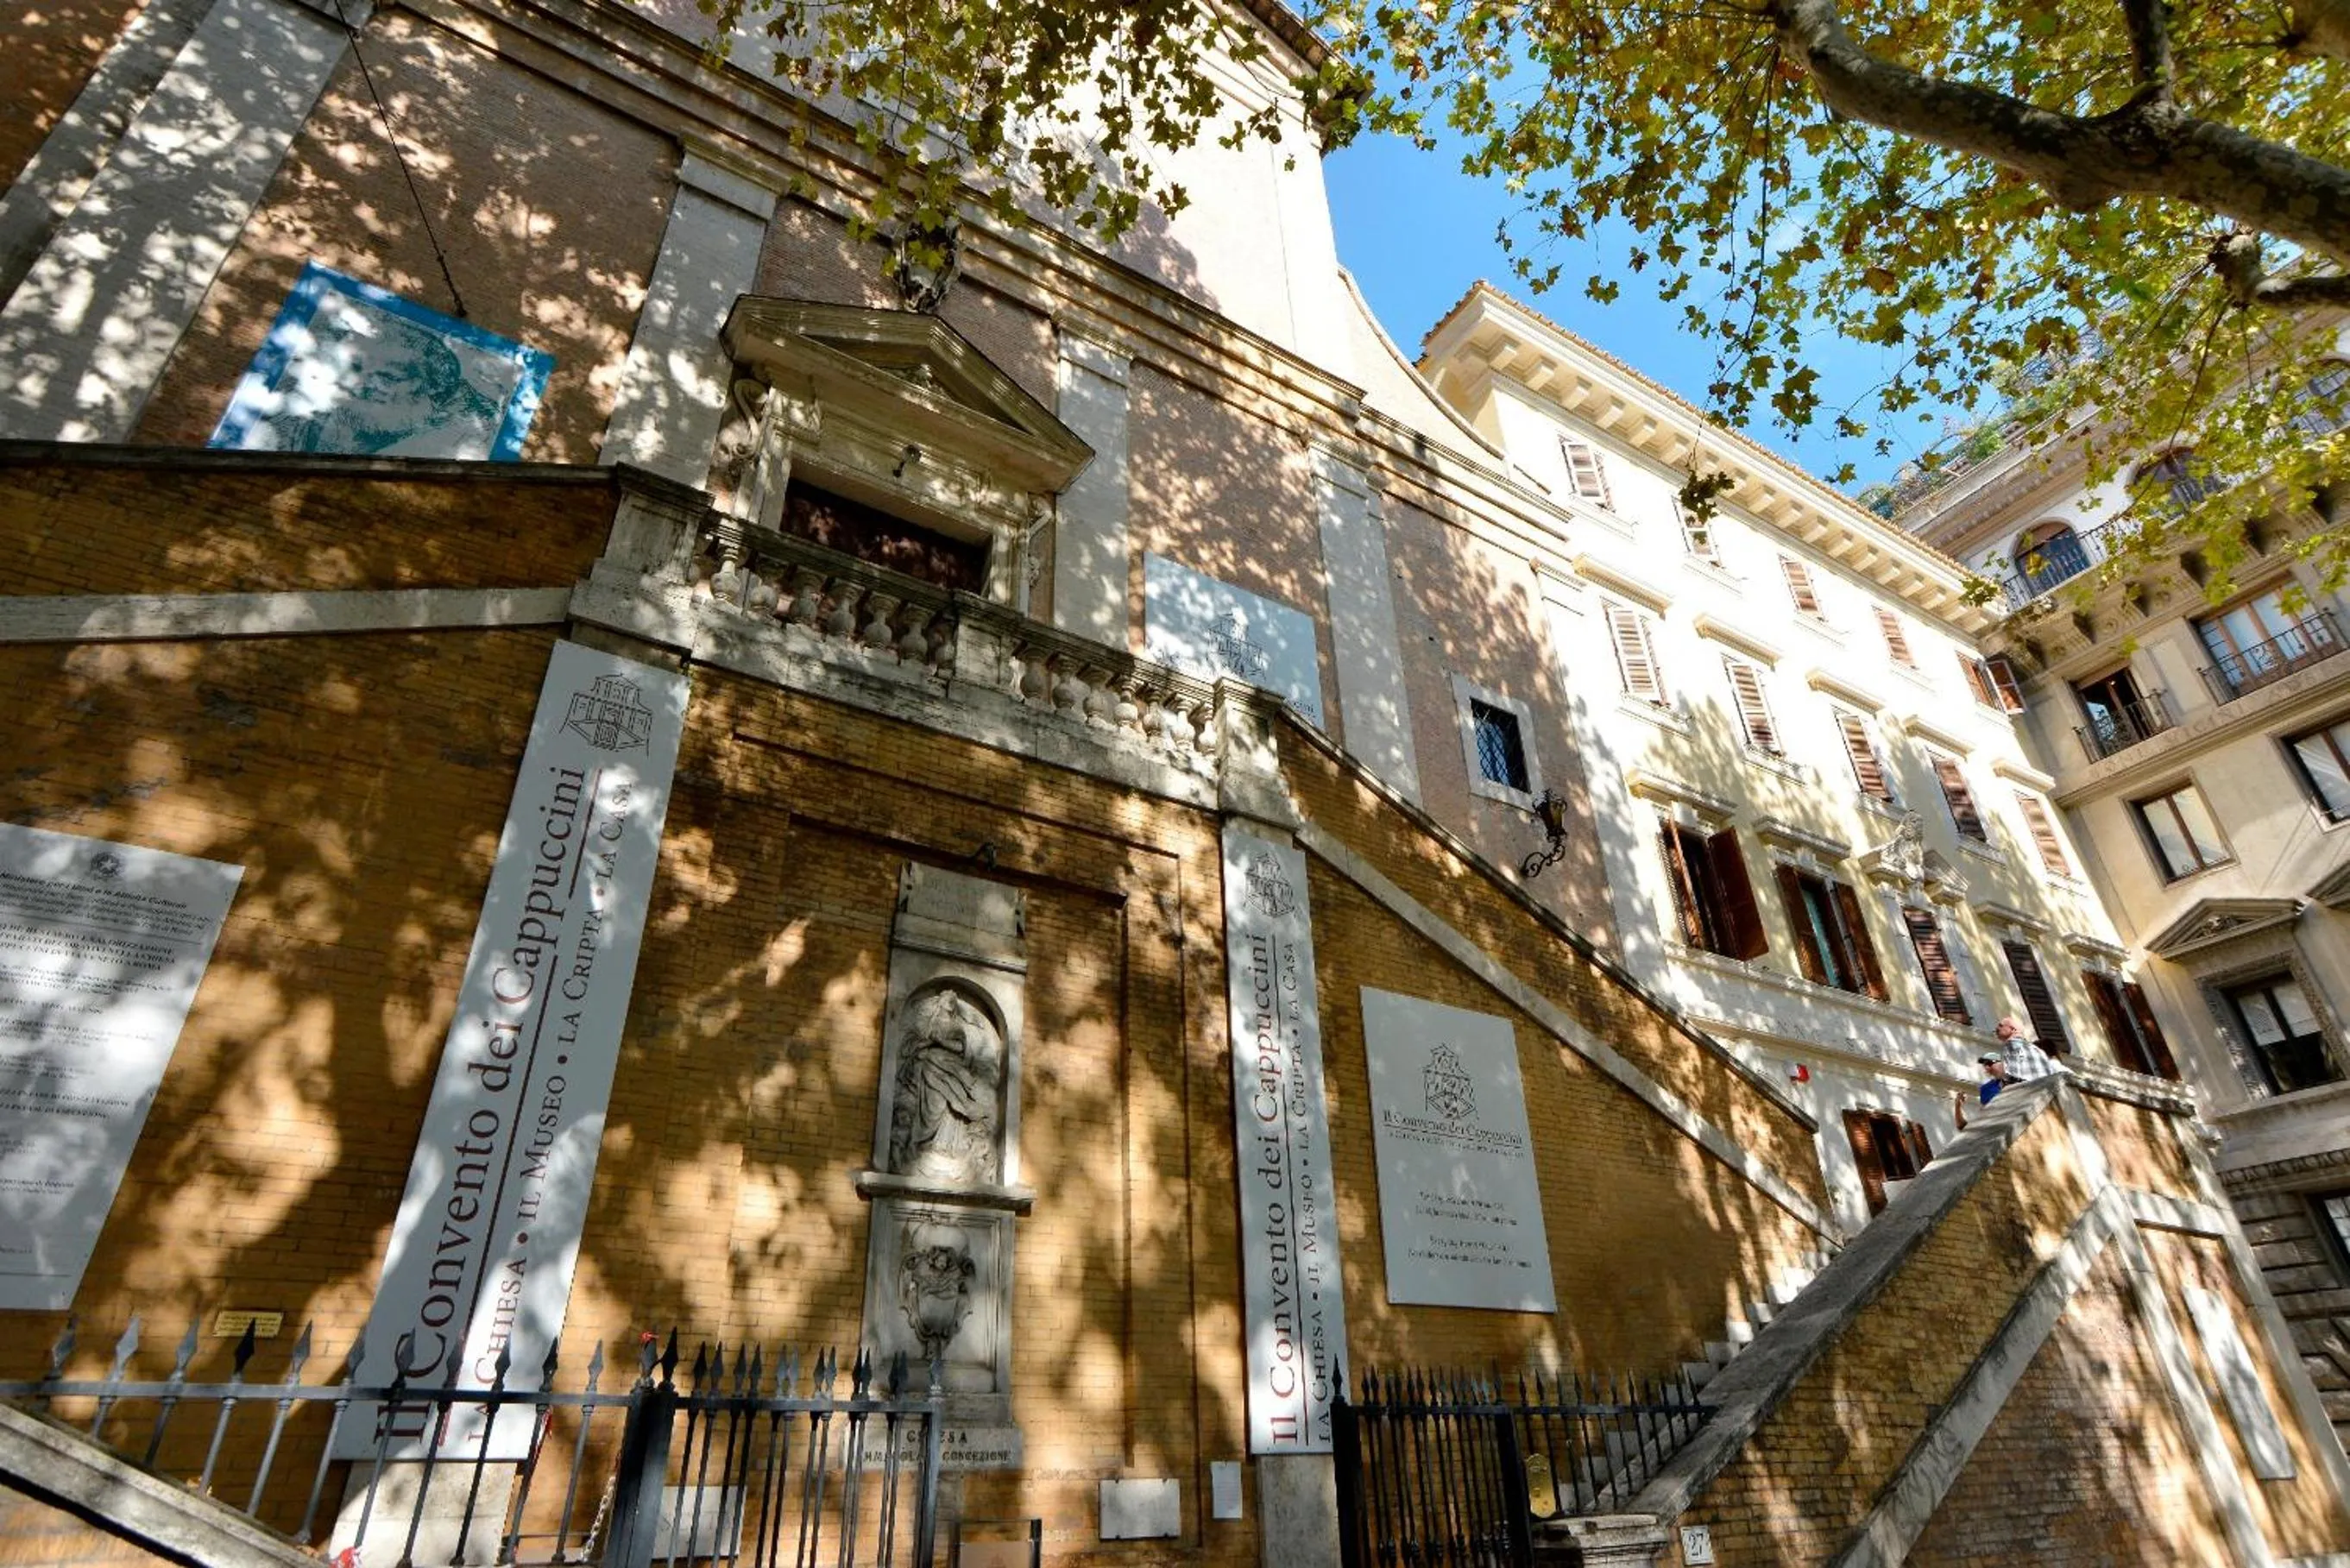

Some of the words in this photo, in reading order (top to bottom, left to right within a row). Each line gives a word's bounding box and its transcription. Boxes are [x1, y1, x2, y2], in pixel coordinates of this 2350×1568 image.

[599, 782, 633, 842] CASA
[491, 766, 586, 1005] Cappuccini
[595, 849, 619, 881] LA
[562, 909, 604, 998] CRIPTA
[468, 1020, 525, 1093] dei
[557, 1012, 582, 1045] LA
[1246, 934, 1282, 1123] Cappuccini
[520, 1074, 567, 1181] MUSEO
[1257, 1135, 1287, 1190] dei
[394, 1111, 500, 1378] Convento
[476, 1256, 527, 1384] CHIESA
[1267, 1203, 1295, 1398] Convento
[1310, 1310, 1329, 1403] CHIESA
[1270, 1414, 1298, 1445] Il
